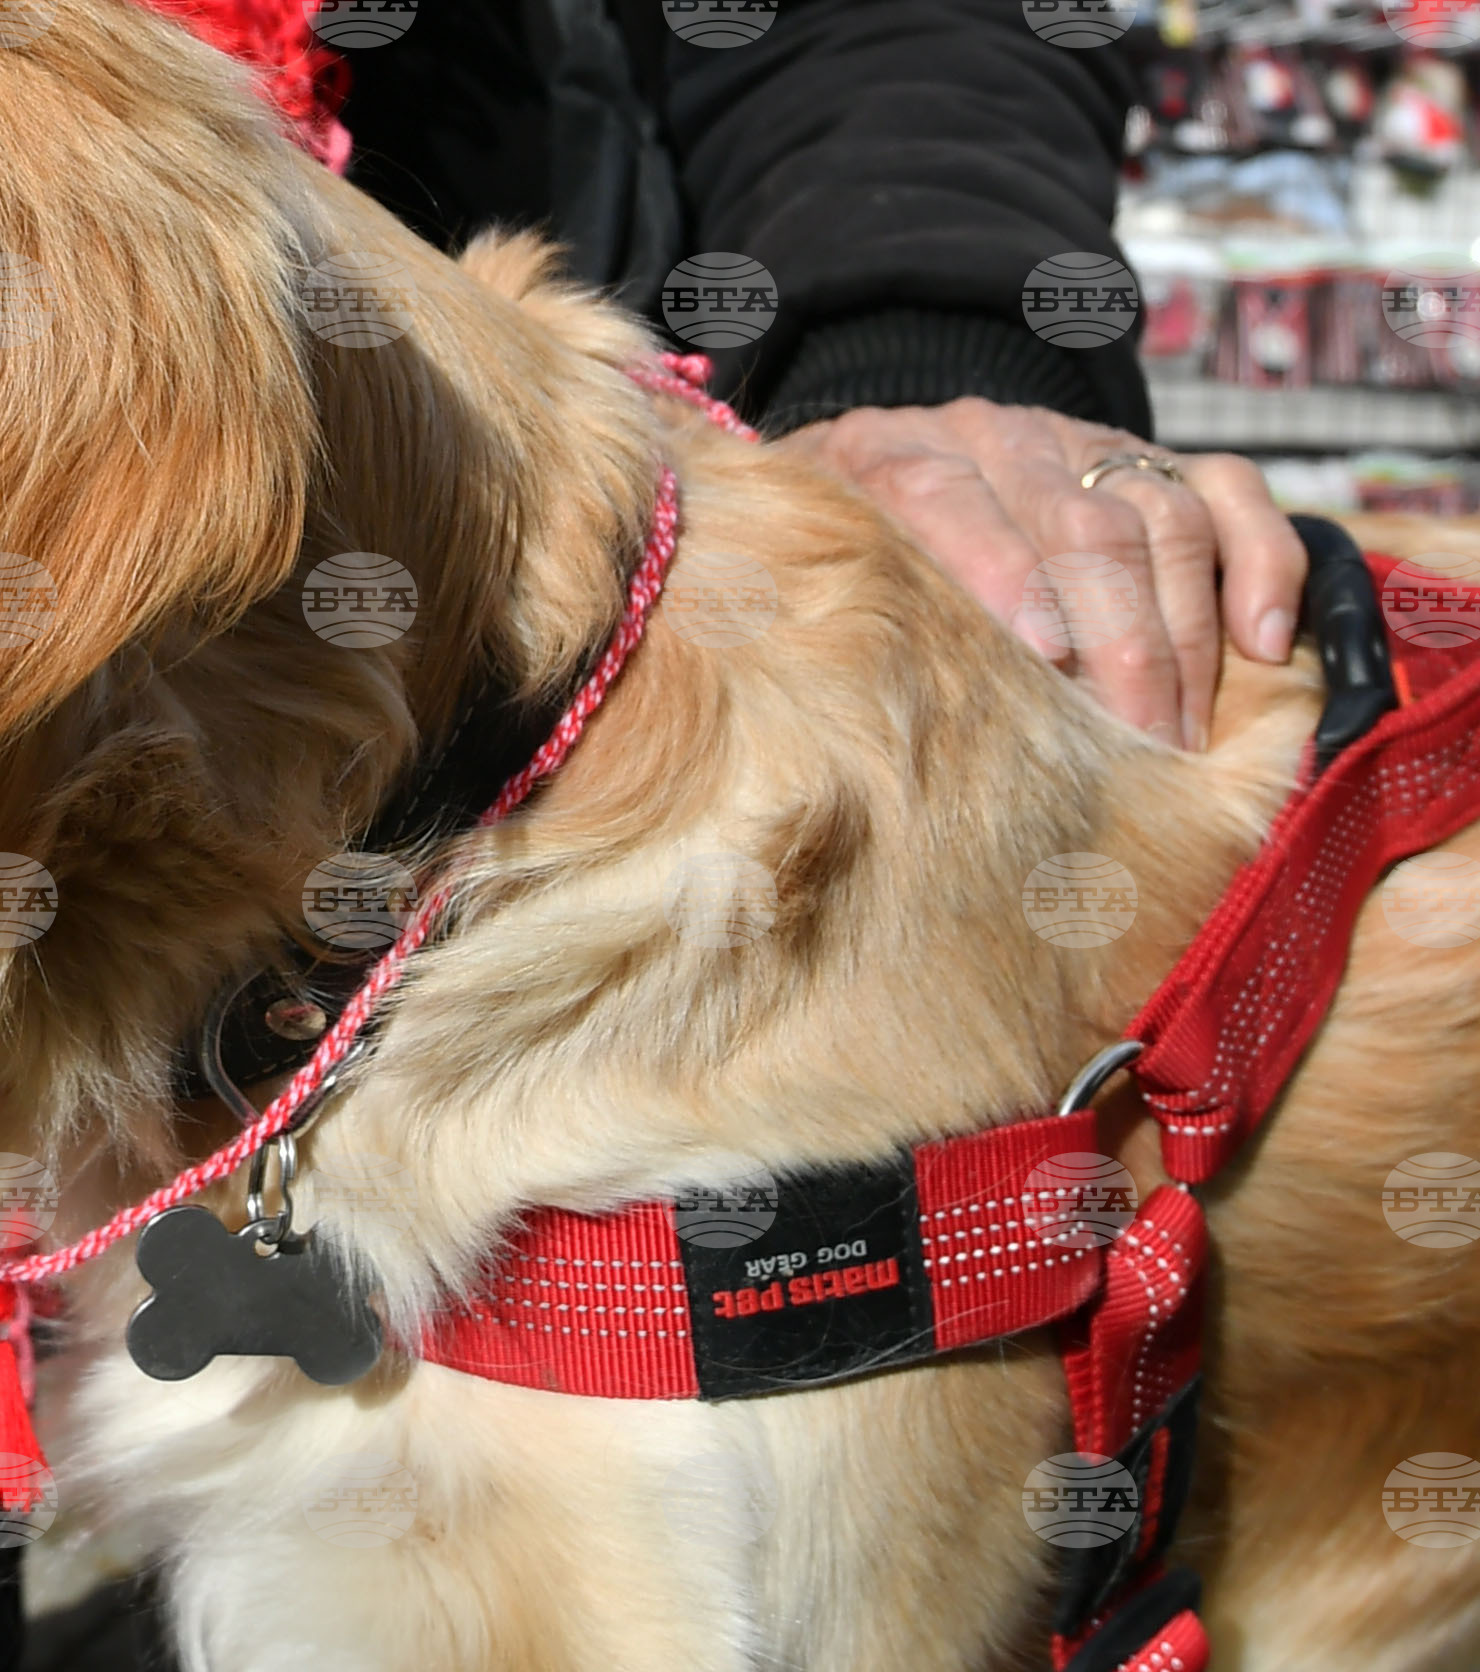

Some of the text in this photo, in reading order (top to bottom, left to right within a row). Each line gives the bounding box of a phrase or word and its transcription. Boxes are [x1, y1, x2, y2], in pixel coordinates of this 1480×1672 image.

[744, 1239, 868, 1278] DOG GEAR
[712, 1257, 900, 1319] matis pet
